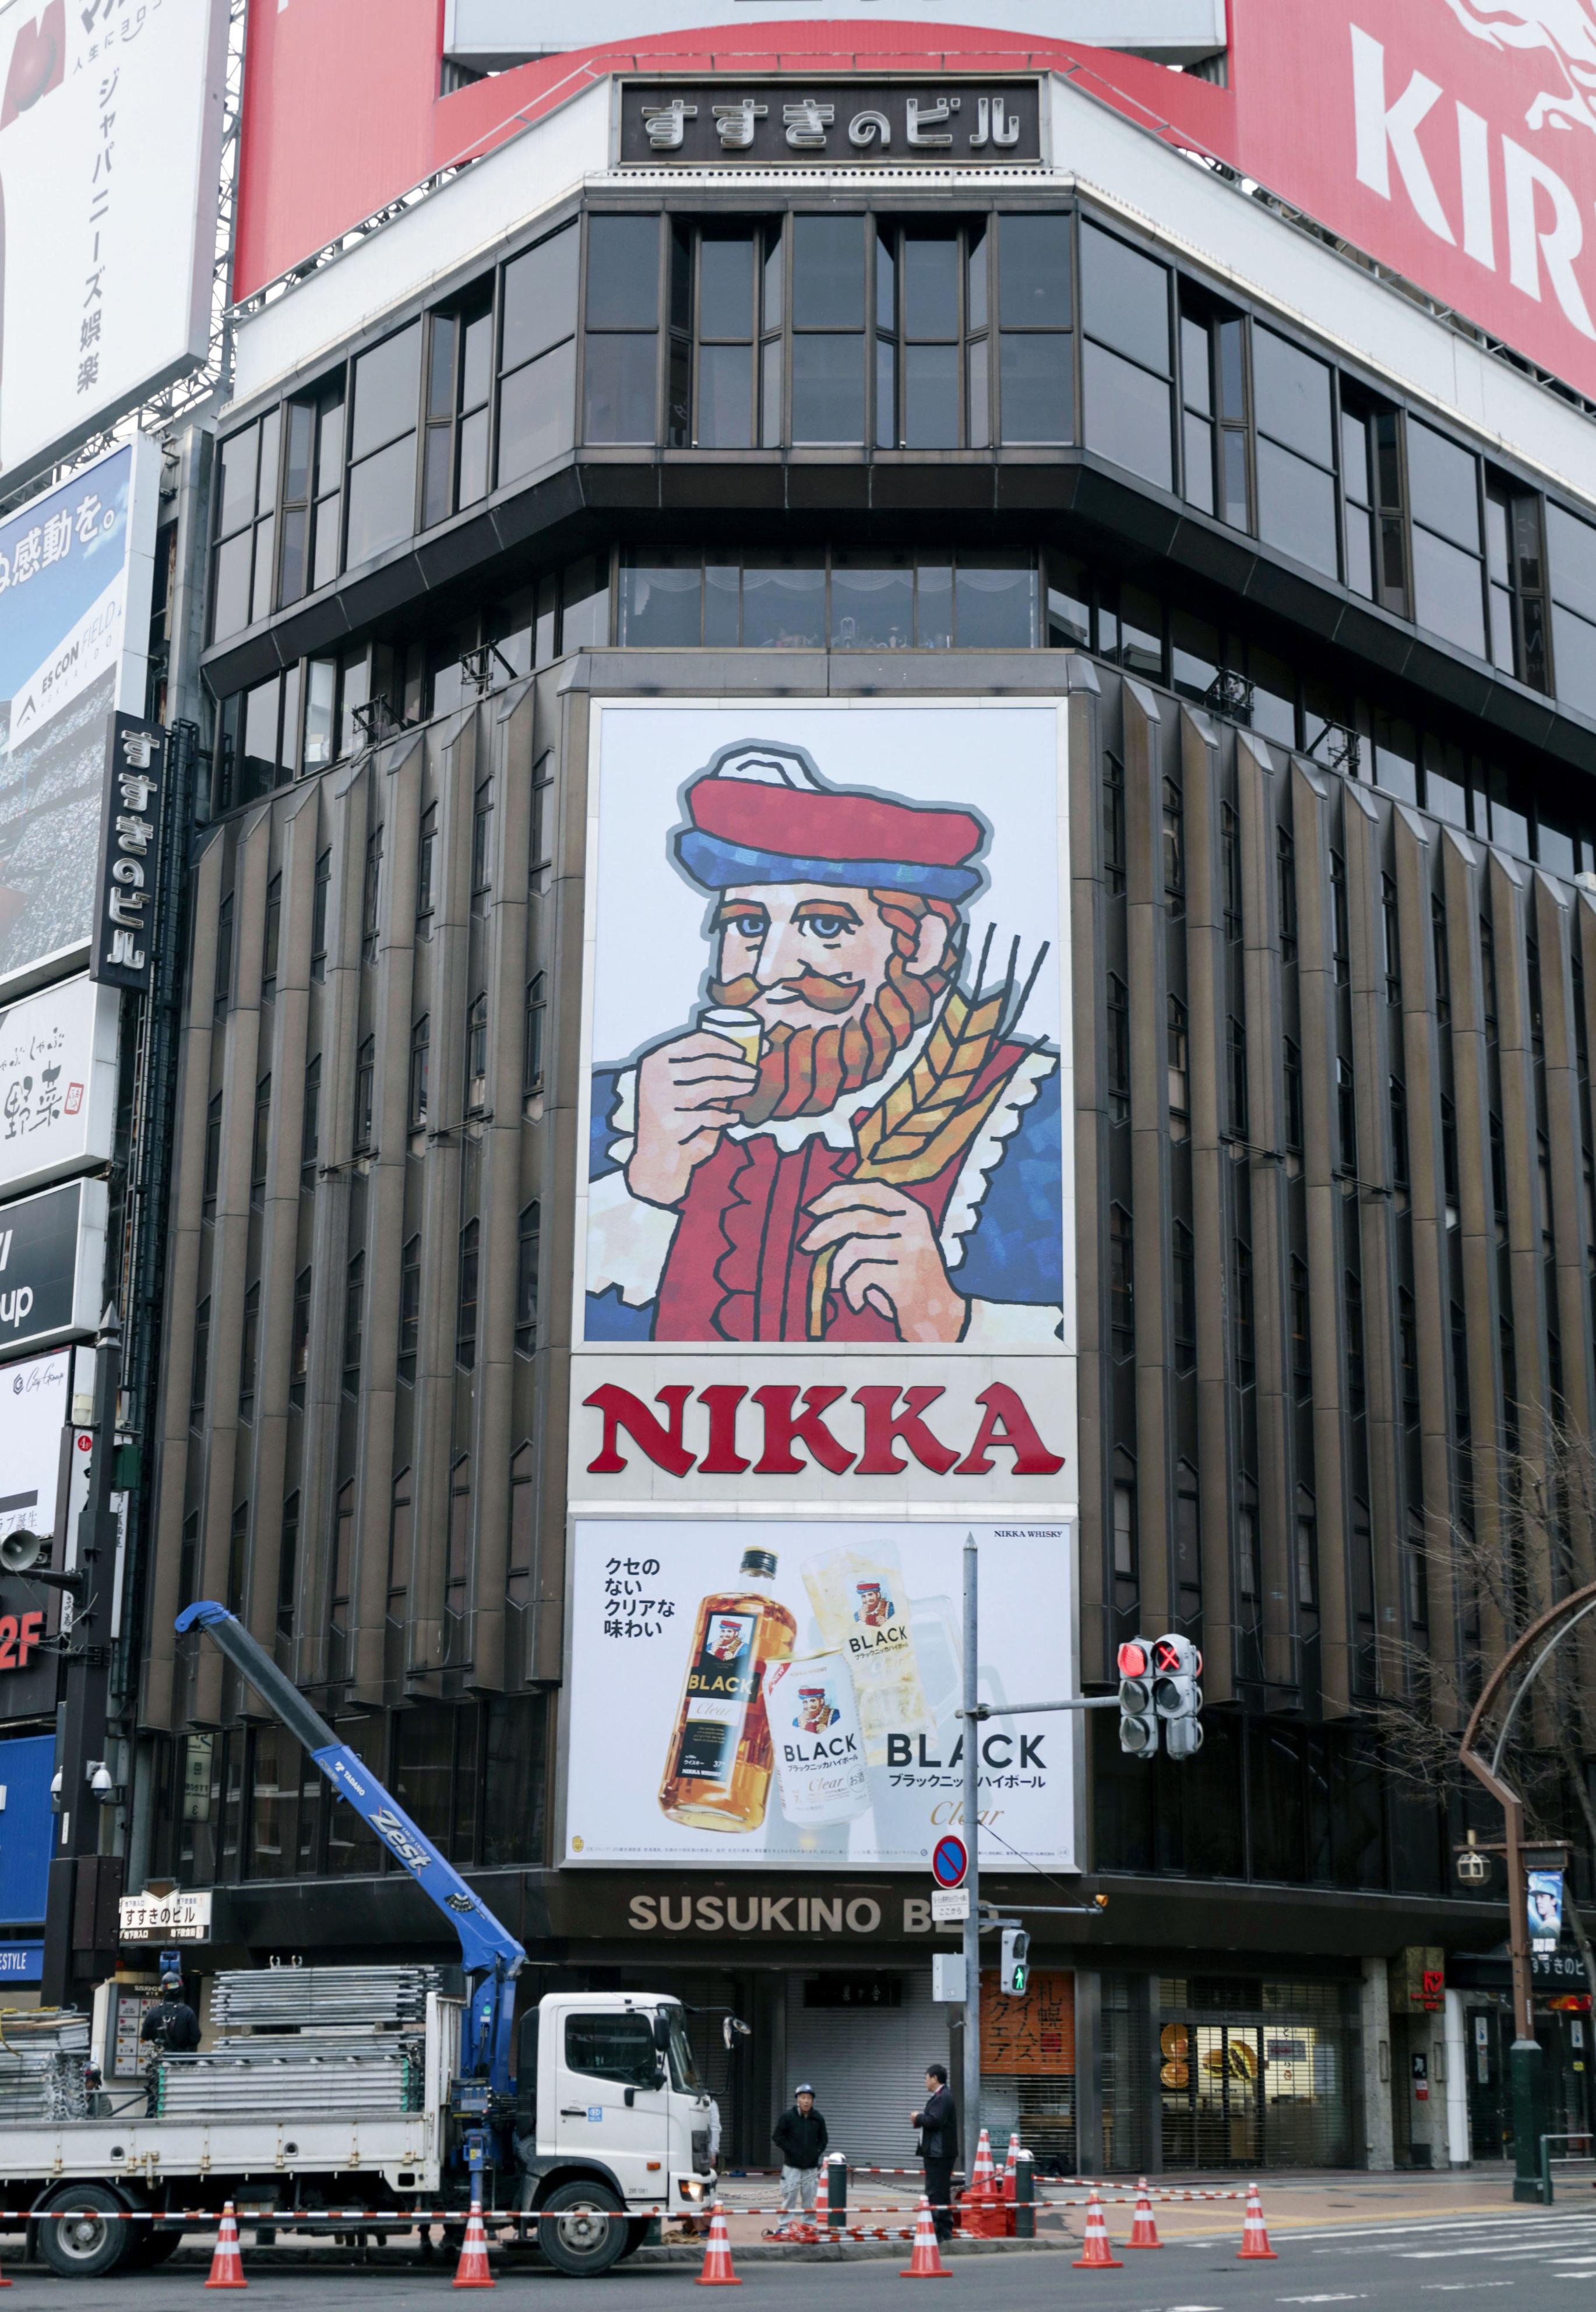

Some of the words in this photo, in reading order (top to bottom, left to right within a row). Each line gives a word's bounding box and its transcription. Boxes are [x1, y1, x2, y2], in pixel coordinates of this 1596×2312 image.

[642, 98, 1019, 150] すすきのビル
[1350, 22, 1596, 343] KIR
[77, 67, 119, 395] ジャパニーズ娯楽
[81, 601, 115, 654] FIELD
[107, 729, 160, 970] すすきのビル
[0, 1287, 33, 1328] up
[582, 1381, 1066, 1478] NIKKA
[79, 1437, 91, 1449] 4F
[605, 1557, 660, 1576] クセの
[604, 1578, 642, 1596] ない
[604, 1599, 675, 1617] クリアな
[0, 1611, 43, 1669] 2F
[604, 1620, 661, 1638] 味わい
[849, 1626, 907, 1653] BLACK
[688, 1674, 753, 1694] BLACK
[696, 1701, 732, 1716] Clear
[784, 1733, 857, 1762] BLACK
[788, 1754, 858, 1772] ブラックニッカハイボール
[344, 1771, 365, 1796] TADANO
[809, 1777, 844, 1792] Clear
[889, 1774, 1046, 1788] ブラックニッハイボール
[368, 1810, 432, 1869] Zest
[126, 1906, 195, 1926] すすきのビル
[628, 1895, 881, 1933] SUSUKINO
